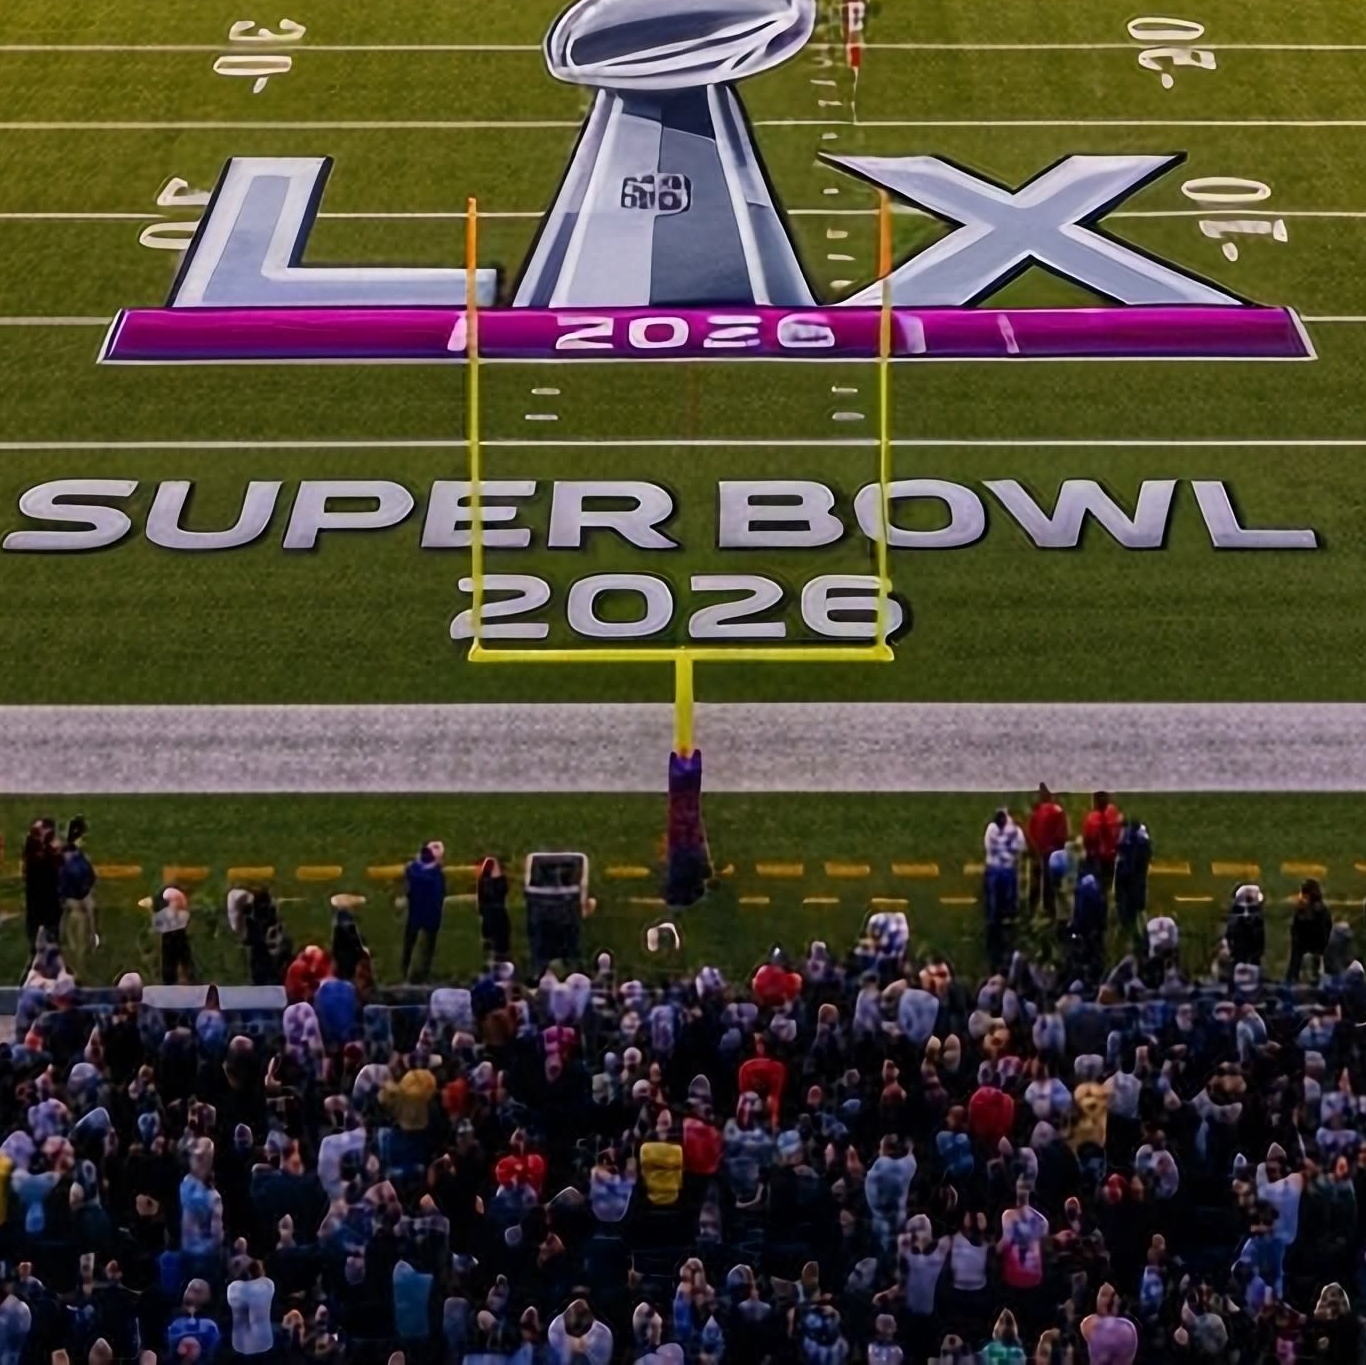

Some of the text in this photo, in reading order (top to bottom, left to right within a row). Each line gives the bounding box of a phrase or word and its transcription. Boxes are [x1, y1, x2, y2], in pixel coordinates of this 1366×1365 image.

[1, 479, 1320, 551] SUPER BOWL
[448, 573, 904, 639] 2026
